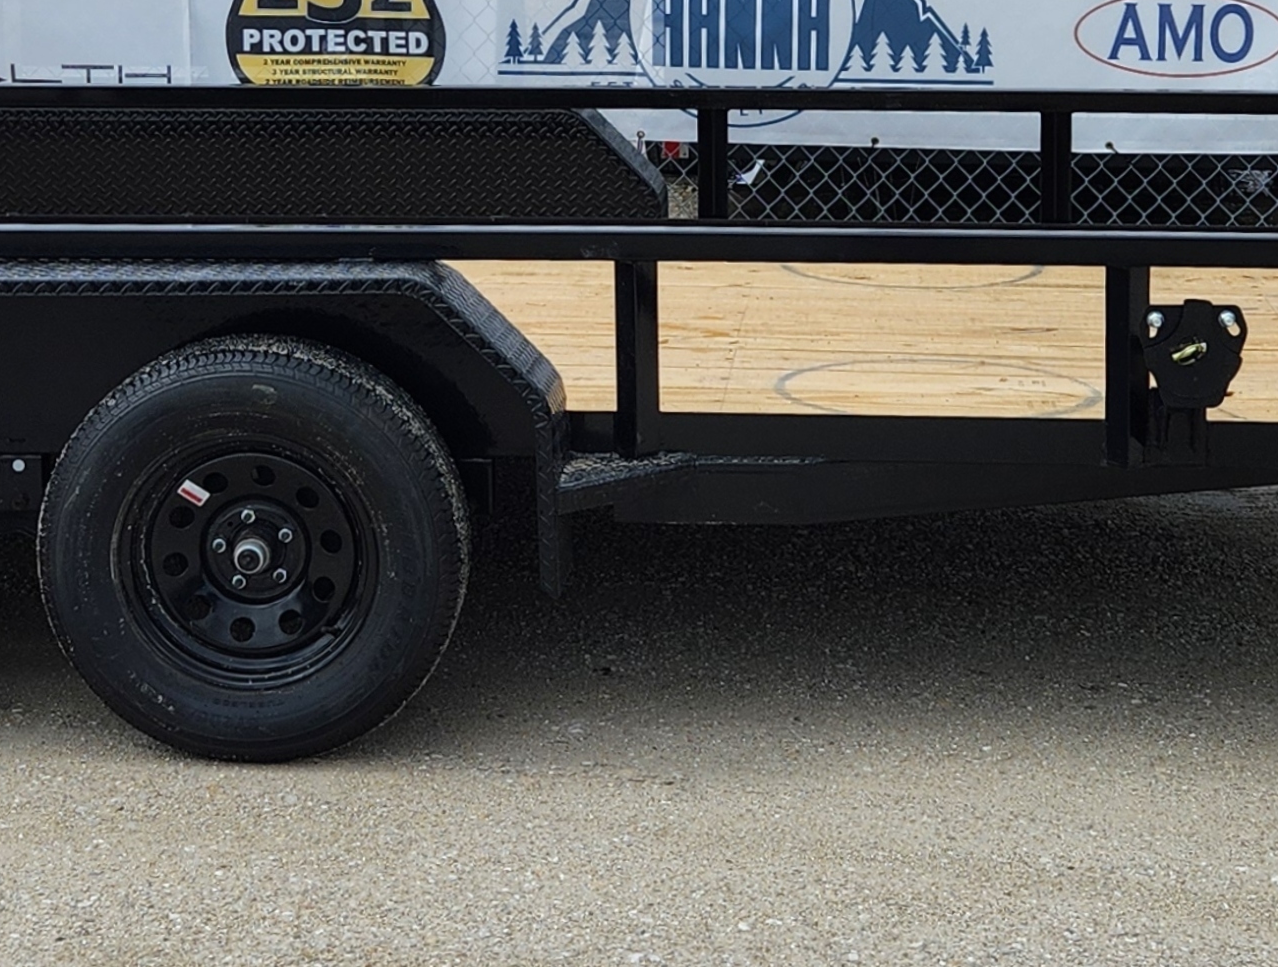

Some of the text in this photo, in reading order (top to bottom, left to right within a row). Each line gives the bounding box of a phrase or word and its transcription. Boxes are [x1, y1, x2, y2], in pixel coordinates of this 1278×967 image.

[1107, 1, 1255, 64] AMO
[242, 29, 429, 54] PROTECTED
[293, 59, 362, 67] COMPREHENSIVE
[364, 59, 407, 67] WARRANTY
[279, 68, 300, 76] YEAR
[302, 68, 353, 76] STRUCTURAL
[294, 78, 335, 86] ROADSIDE
[337, 78, 406, 86] REIMBURSEMENT
